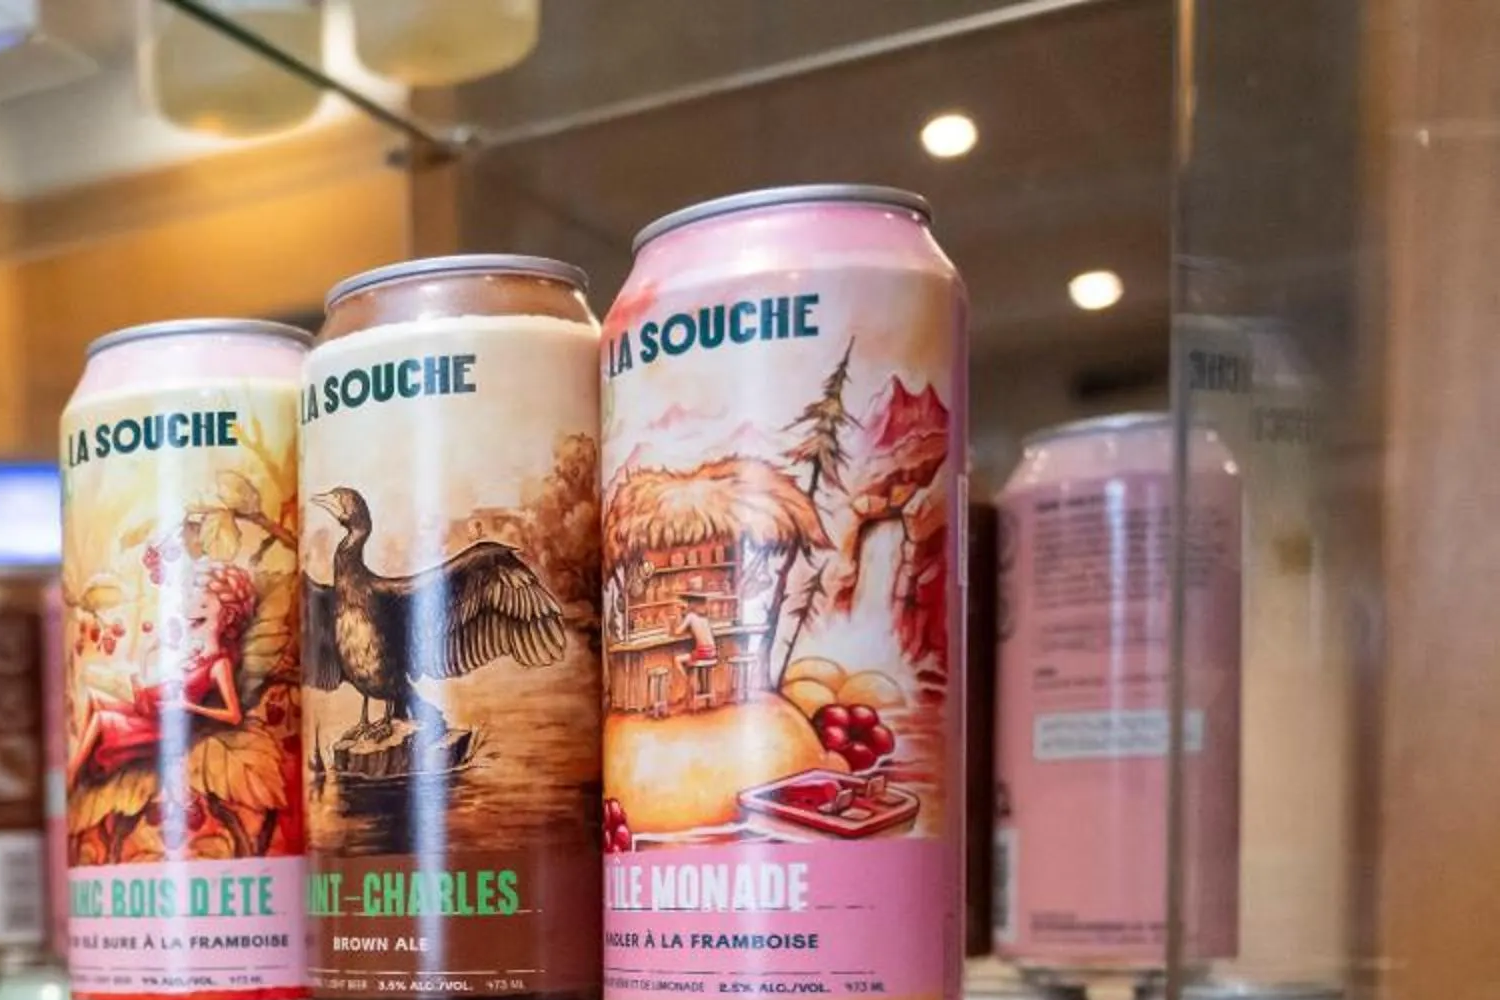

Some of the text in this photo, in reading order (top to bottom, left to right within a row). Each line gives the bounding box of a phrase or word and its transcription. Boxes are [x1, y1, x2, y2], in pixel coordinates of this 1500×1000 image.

[609, 293, 819, 378] LA SOUCHE
[301, 354, 476, 426] LA SOUCHE
[68, 411, 238, 468] LA SOUCHE
[112, 877, 177, 919] BOIS
[651, 863, 808, 913] MONADE
[143, 933, 154, 950] À
[161, 936, 183, 950] LA
[190, 933, 289, 949] FRAMBOISE
[333, 936, 428, 952] BROWN ALE
[661, 934, 684, 949] LA
[691, 933, 819, 950] FRAMBOISE
